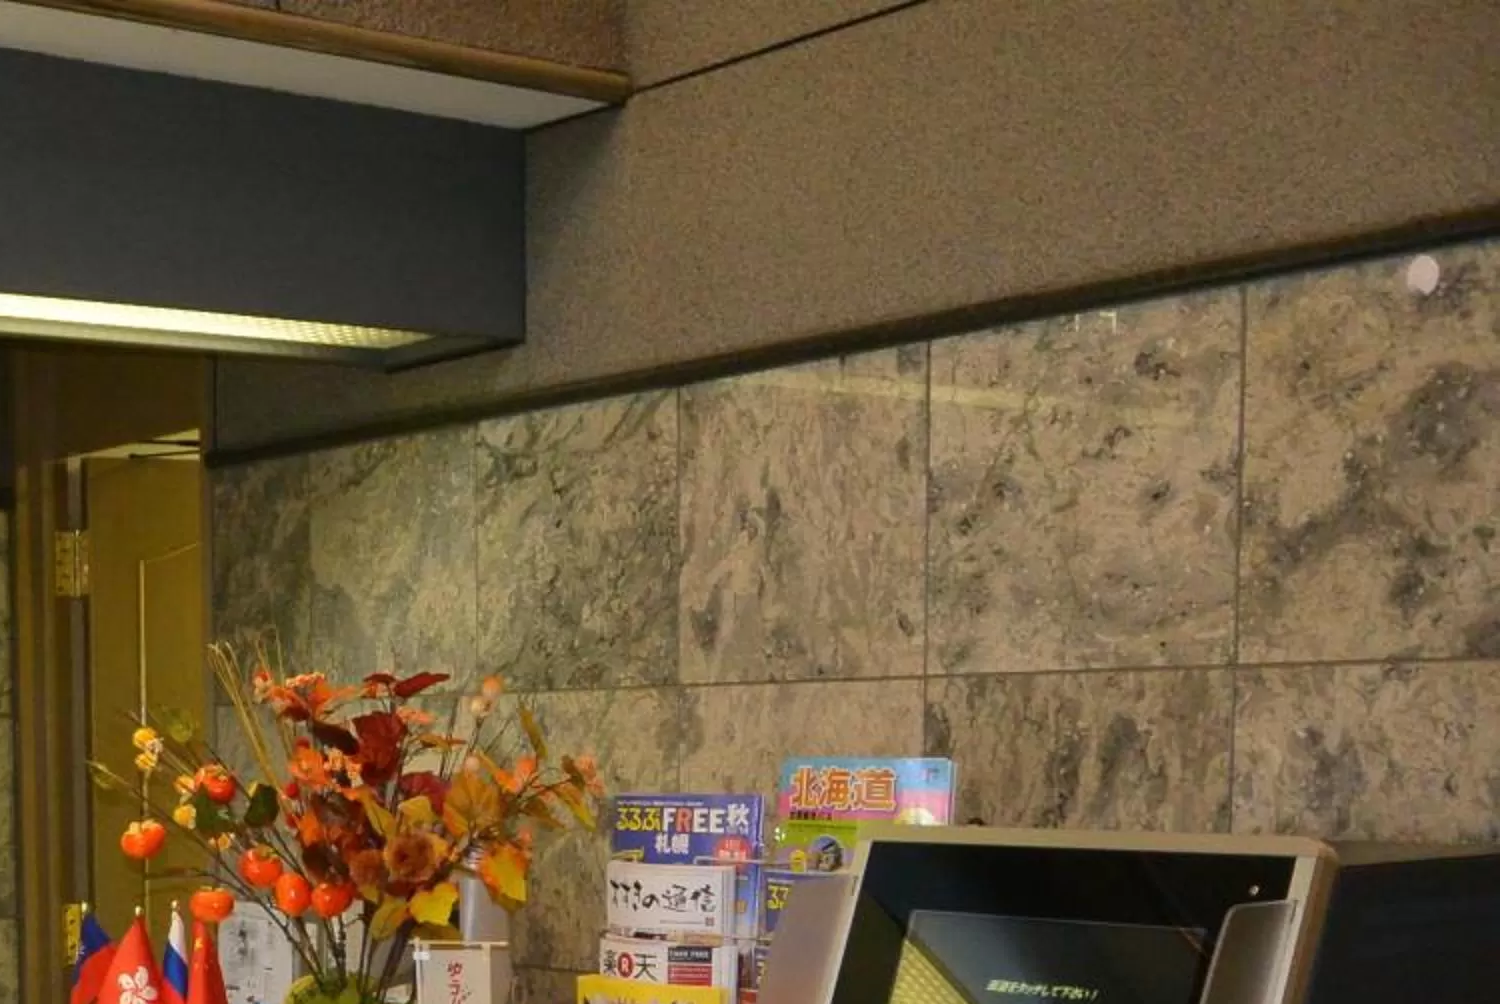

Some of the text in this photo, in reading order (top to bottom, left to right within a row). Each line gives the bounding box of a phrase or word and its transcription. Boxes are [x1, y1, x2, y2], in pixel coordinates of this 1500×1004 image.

[789, 765, 899, 812] 北海道
[654, 832, 690, 855] 札幌
